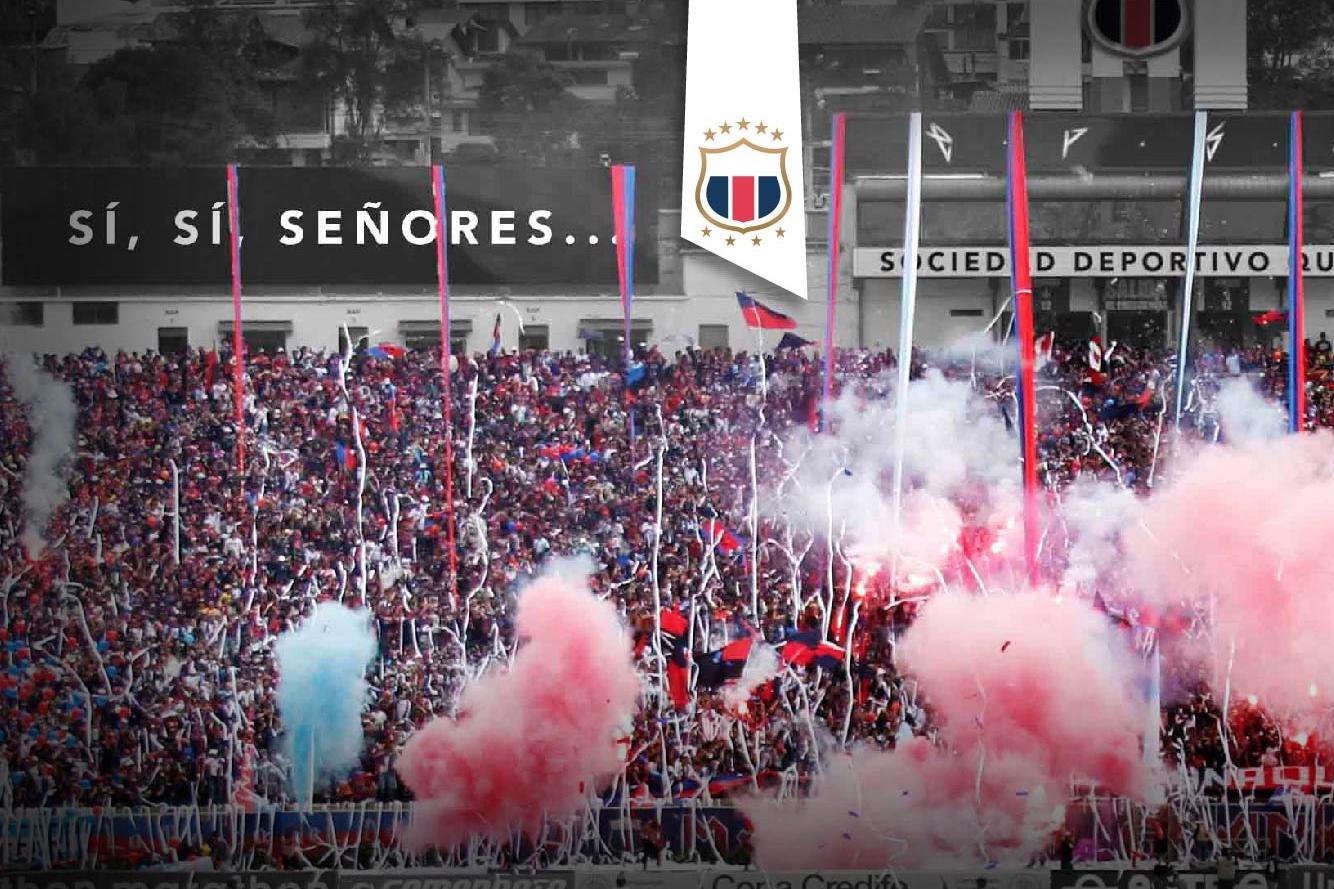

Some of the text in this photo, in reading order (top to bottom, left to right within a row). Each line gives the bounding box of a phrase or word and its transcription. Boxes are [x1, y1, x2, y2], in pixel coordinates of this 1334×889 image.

[68, 201, 139, 251] SÍ,
[880, 251, 1055, 272] SCIEDD
[1073, 251, 1270, 272] DEPORTIVO
